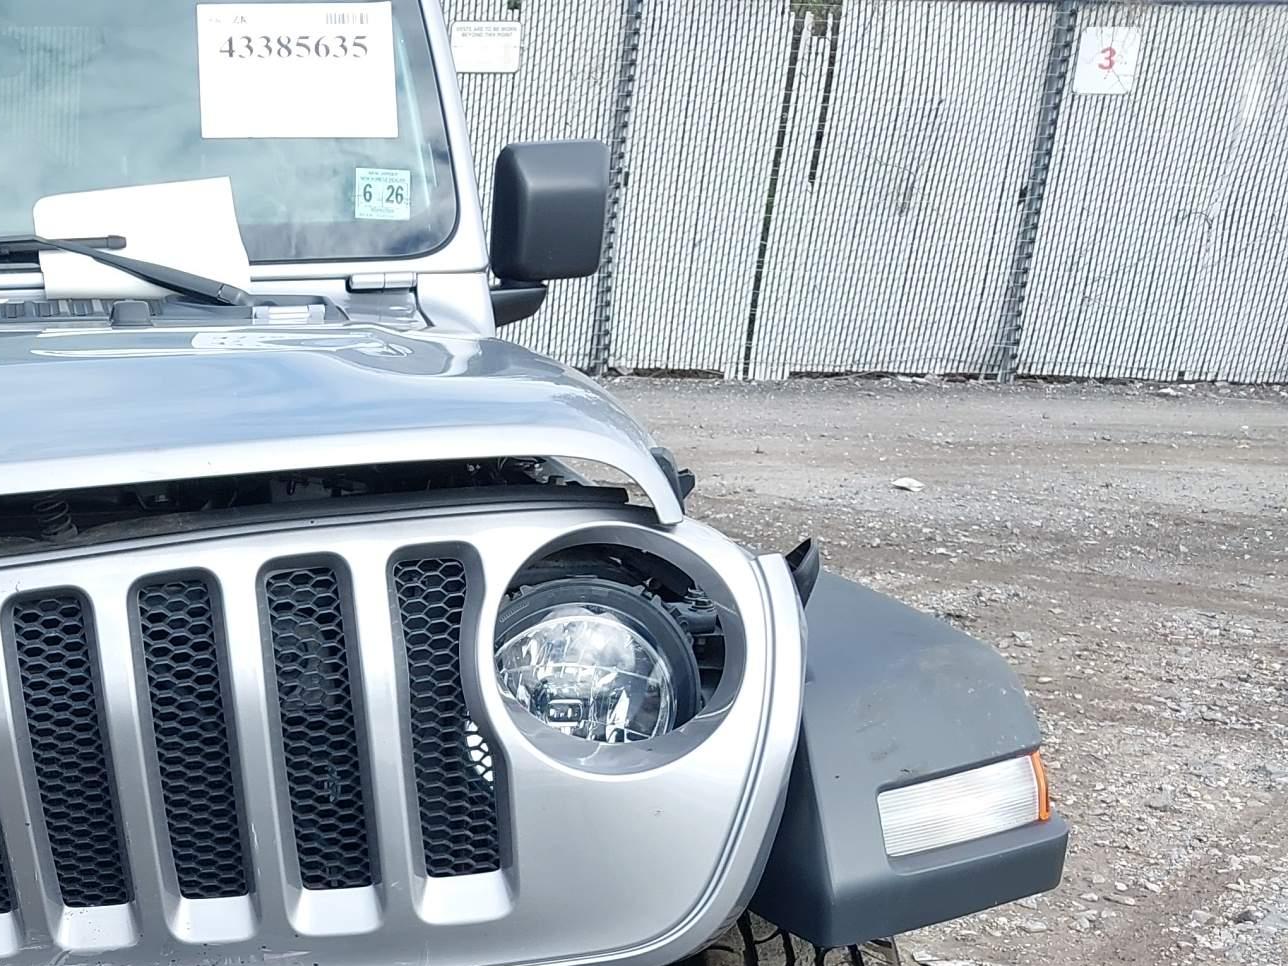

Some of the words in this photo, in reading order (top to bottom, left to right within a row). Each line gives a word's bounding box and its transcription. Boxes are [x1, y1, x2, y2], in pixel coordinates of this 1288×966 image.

[218, 35, 369, 58] 43385635
[1098, 47, 1116, 70] 3
[363, 183, 373, 202] 6
[385, 184, 404, 204] 26
